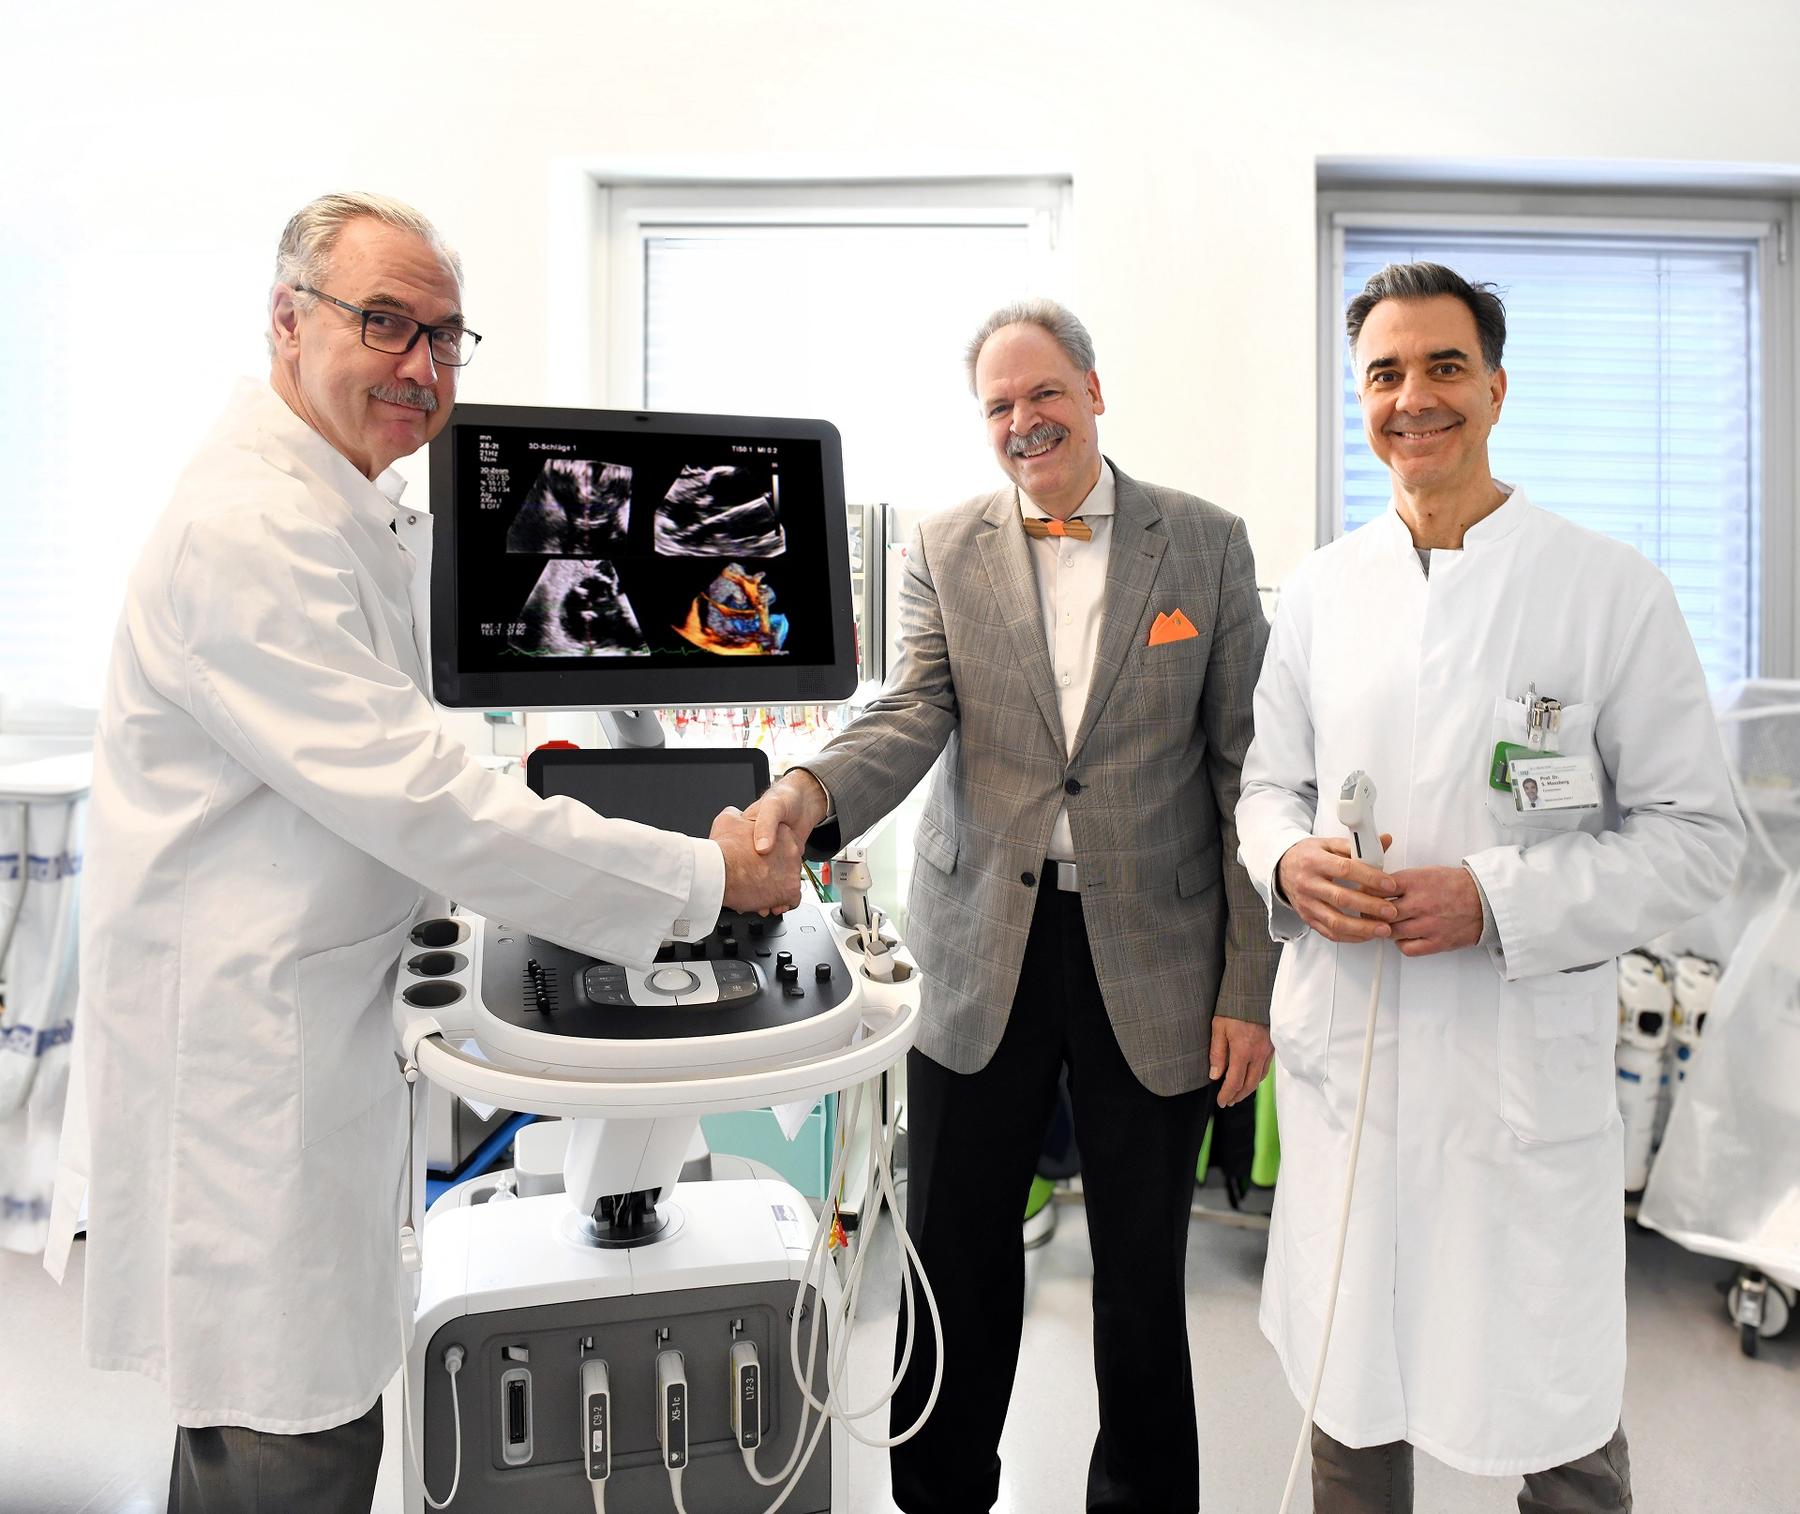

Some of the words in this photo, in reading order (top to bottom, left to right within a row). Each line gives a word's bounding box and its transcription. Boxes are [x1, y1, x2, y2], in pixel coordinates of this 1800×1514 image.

[746, 1377, 754, 1400] L12-3
[593, 1406, 602, 1426] C9-2
[672, 1397, 680, 1421] X5-1c
